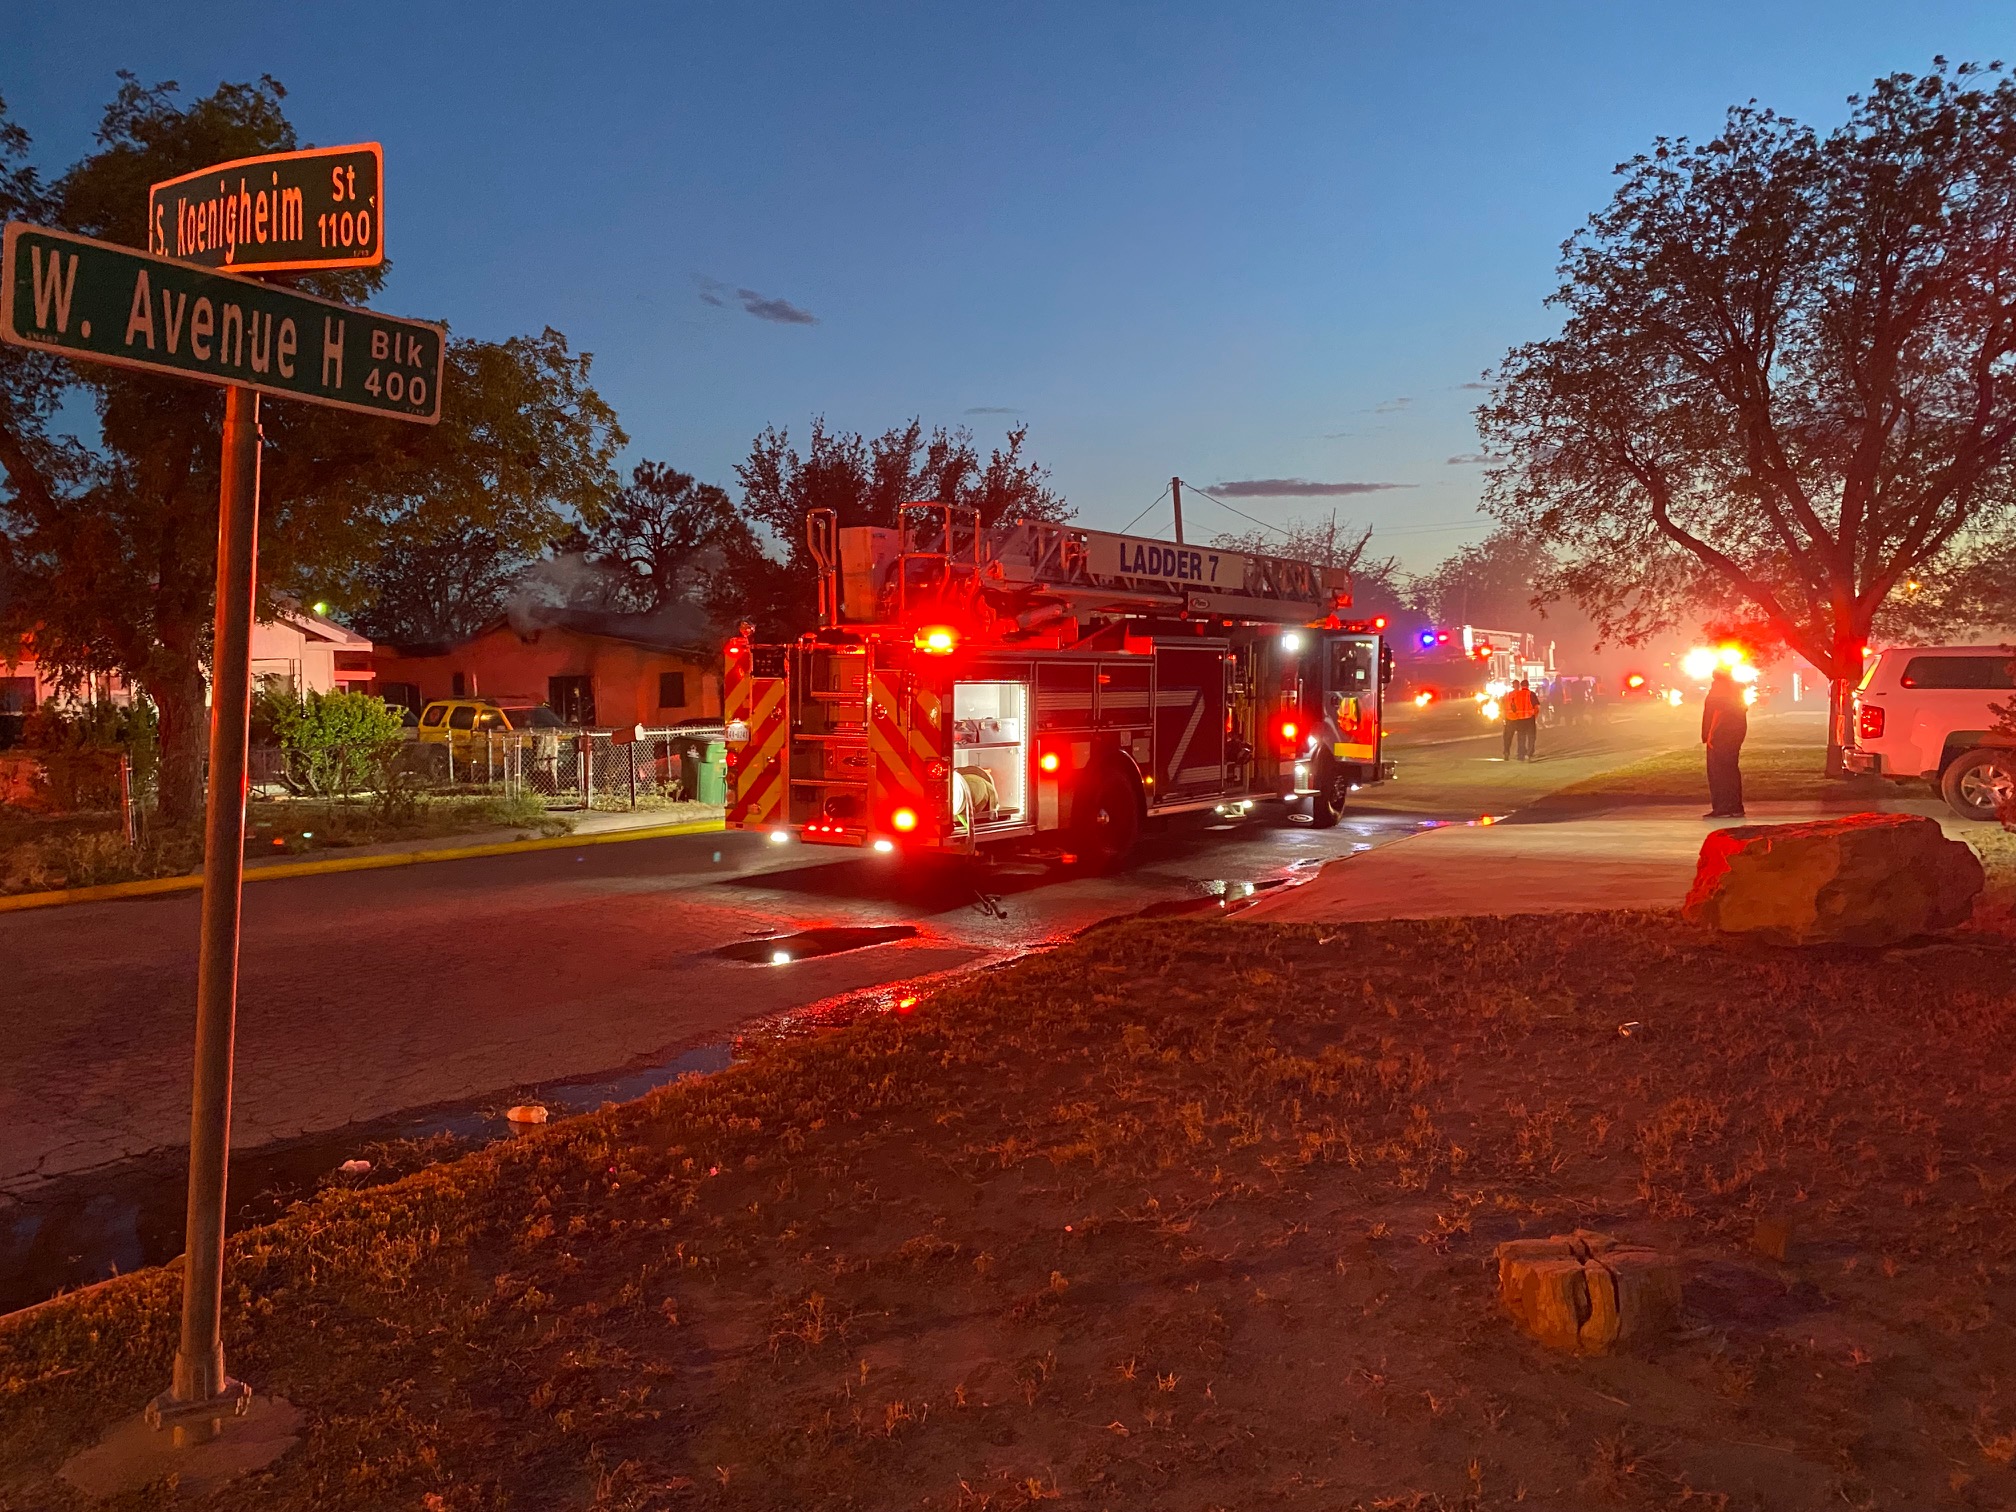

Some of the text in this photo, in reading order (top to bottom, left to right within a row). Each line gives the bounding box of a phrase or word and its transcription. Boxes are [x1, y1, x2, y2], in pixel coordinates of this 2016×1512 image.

[332, 165, 355, 201] St
[156, 171, 303, 263] S. Koenigheim
[318, 210, 370, 247] 1100
[31, 245, 345, 389] W. Avenue H
[371, 329, 422, 368] Blk
[364, 368, 427, 405] 400
[1120, 543, 1219, 582] LADDER 7
